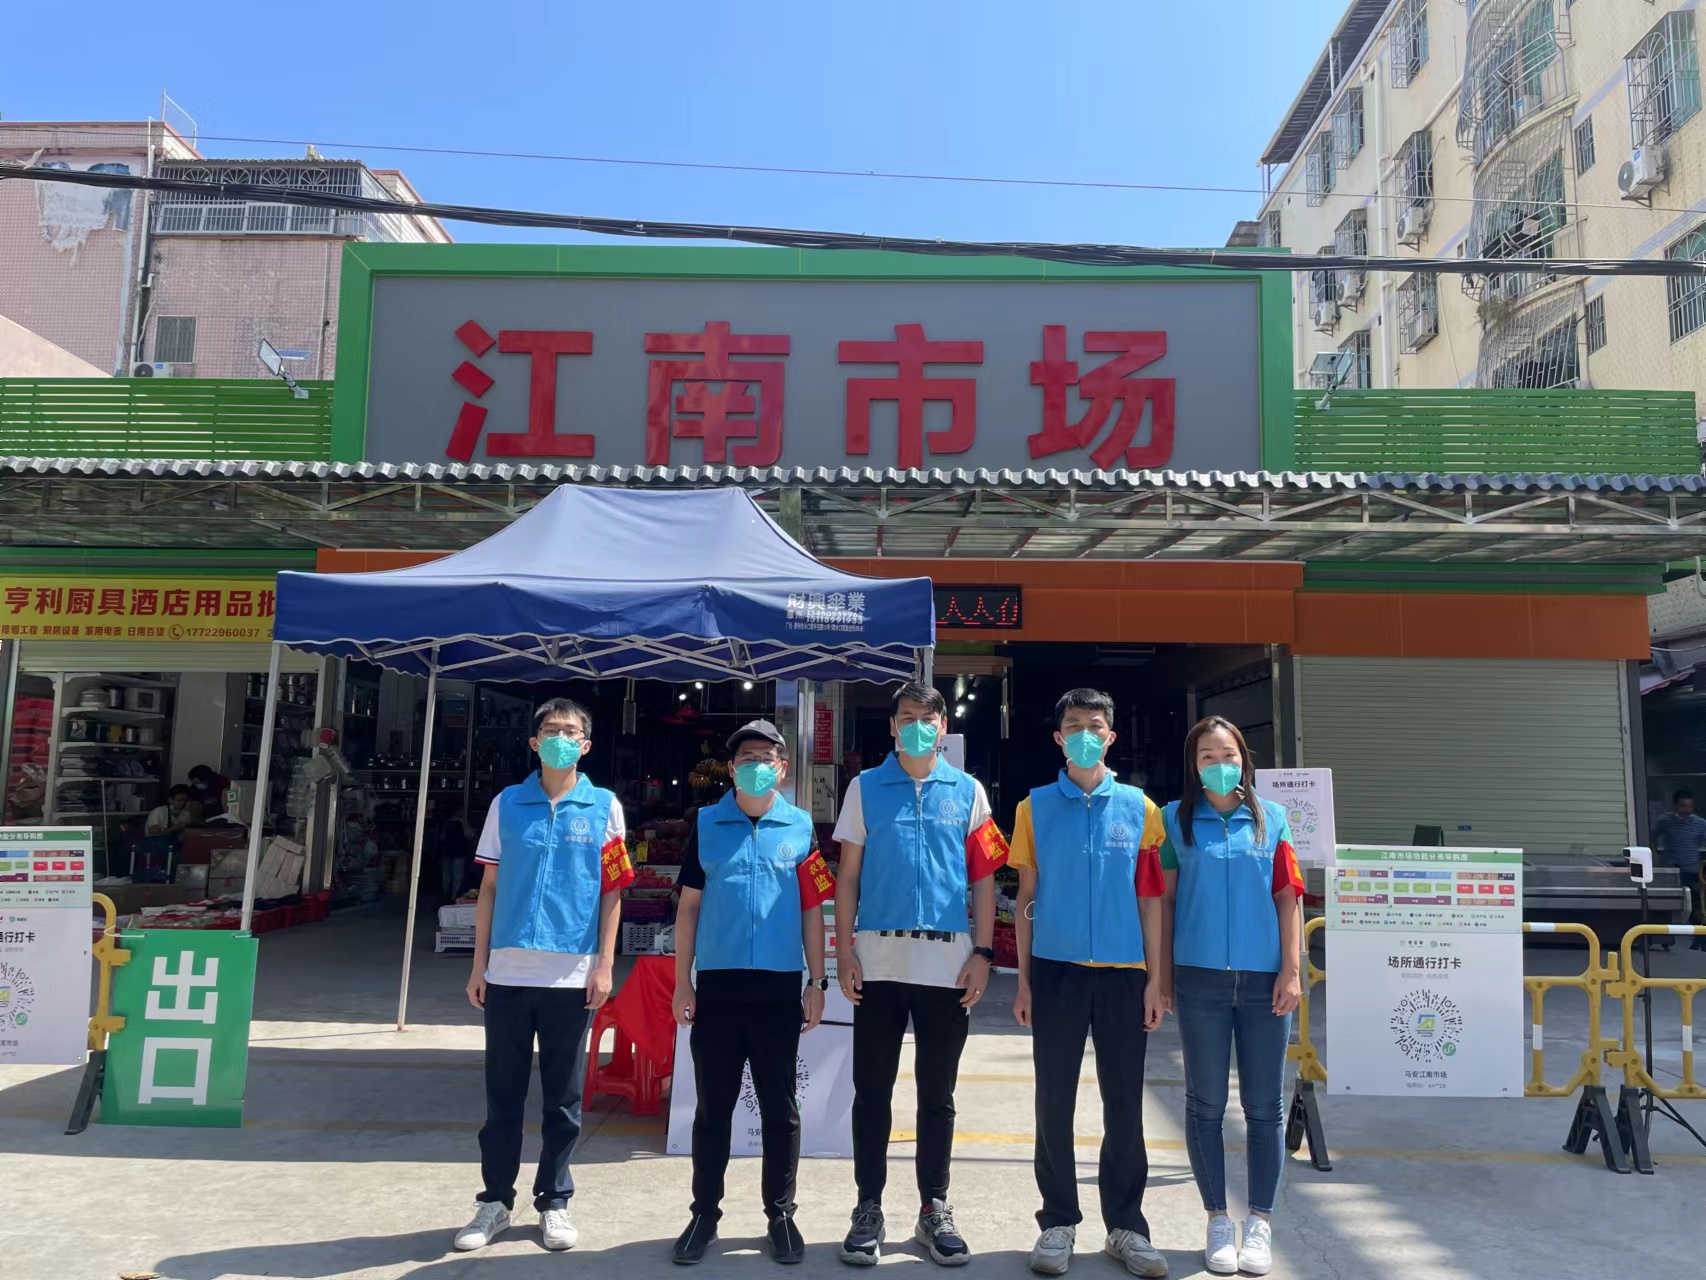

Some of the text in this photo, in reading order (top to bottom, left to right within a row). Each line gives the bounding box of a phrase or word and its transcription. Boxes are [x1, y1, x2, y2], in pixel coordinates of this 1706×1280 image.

[445, 319, 1177, 468] 江南市场
[185, 627, 260, 638] 17722960037
[1272, 780, 1316, 789] 场所通行打卡
[0, 832, 43, 840] 能分布导购图
[1387, 955, 1462, 970] 场所通行打卡
[138, 950, 219, 1106] 出口
[1404, 1070, 1448, 1079] 马安江南市场
